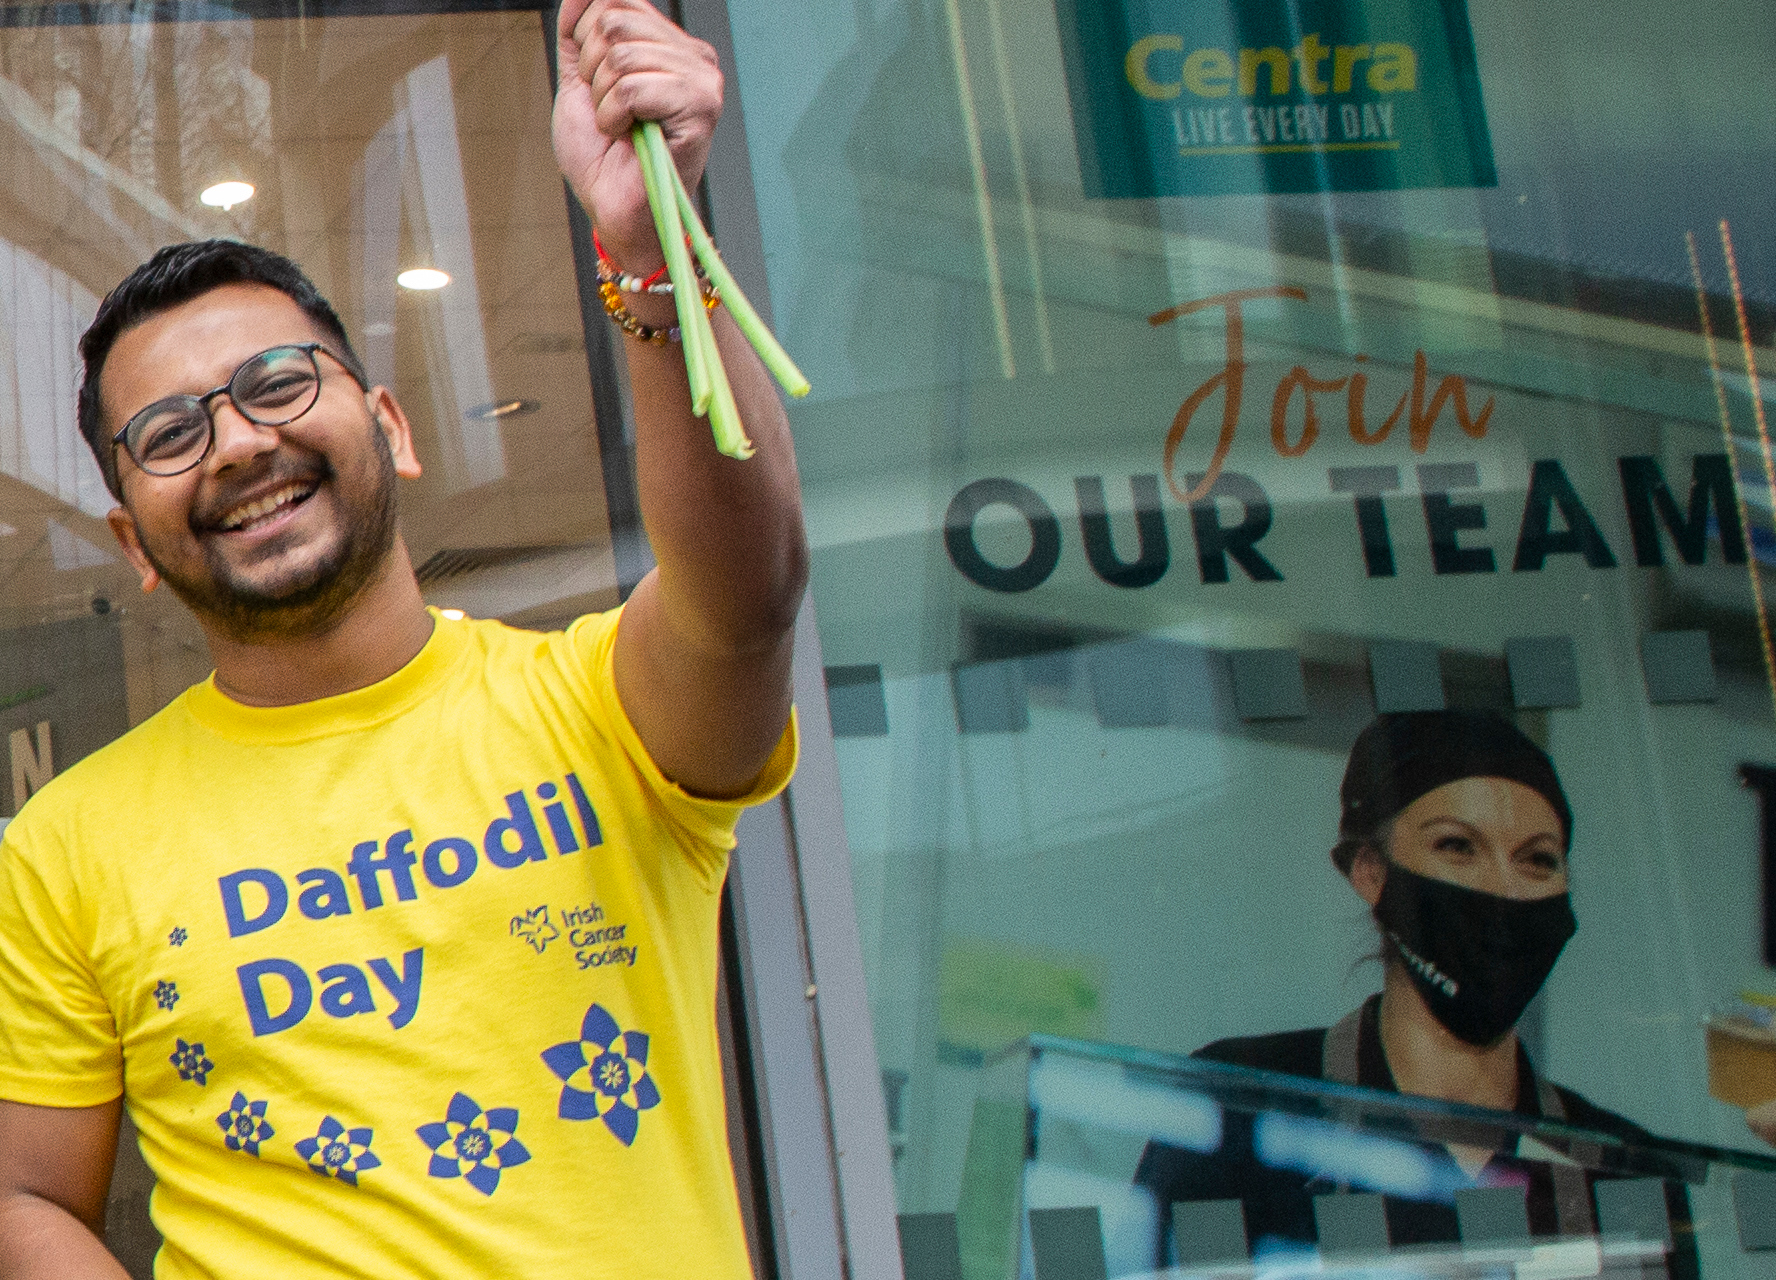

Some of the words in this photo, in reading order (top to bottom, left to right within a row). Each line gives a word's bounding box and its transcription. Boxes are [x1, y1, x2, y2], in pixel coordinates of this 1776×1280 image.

[1125, 32, 1418, 100] Centra
[1172, 106, 1234, 146] LIVE
[1241, 104, 1329, 144] EVERY
[1340, 102, 1395, 141] DAY
[1148, 288, 1496, 503] Join
[943, 473, 1285, 595] OUR
[1328, 453, 1748, 580] TEAM
[217, 772, 604, 939] Daffodil
[561, 902, 604, 928] Irish
[569, 924, 627, 948] Cancer
[236, 947, 425, 1037] Day
[574, 945, 638, 971] Society
